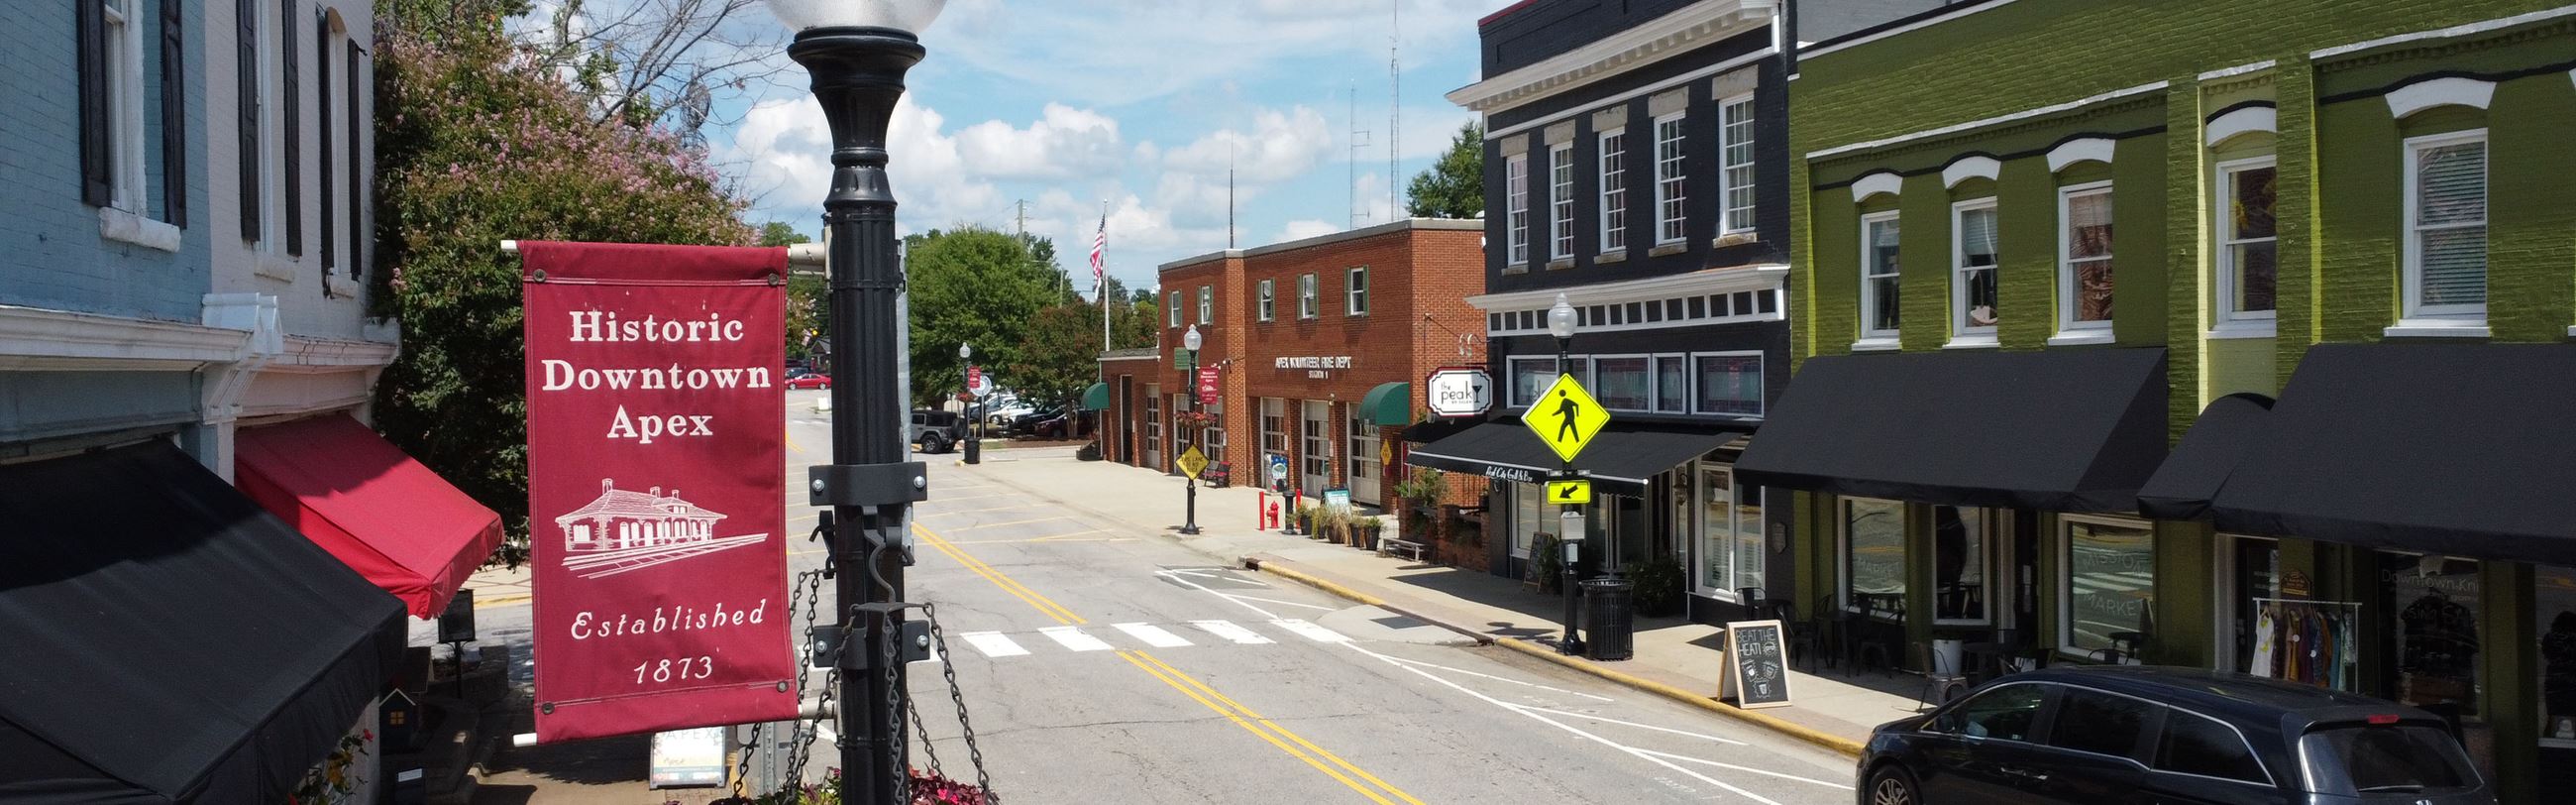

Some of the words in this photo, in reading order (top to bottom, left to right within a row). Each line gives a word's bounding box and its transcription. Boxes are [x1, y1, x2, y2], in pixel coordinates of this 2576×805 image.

[569, 310, 744, 342] Historic
[541, 359, 771, 391] Downtown
[1336, 357, 1351, 368] DEPT
[1441, 381, 1472, 404] peak
[606, 403, 713, 444] Apex
[2382, 569, 2455, 589] Downtown
[571, 598, 767, 640] Established
[1736, 629, 1757, 643] BEAT
[1758, 628, 1775, 641] THE
[633, 655, 713, 684] 1873
